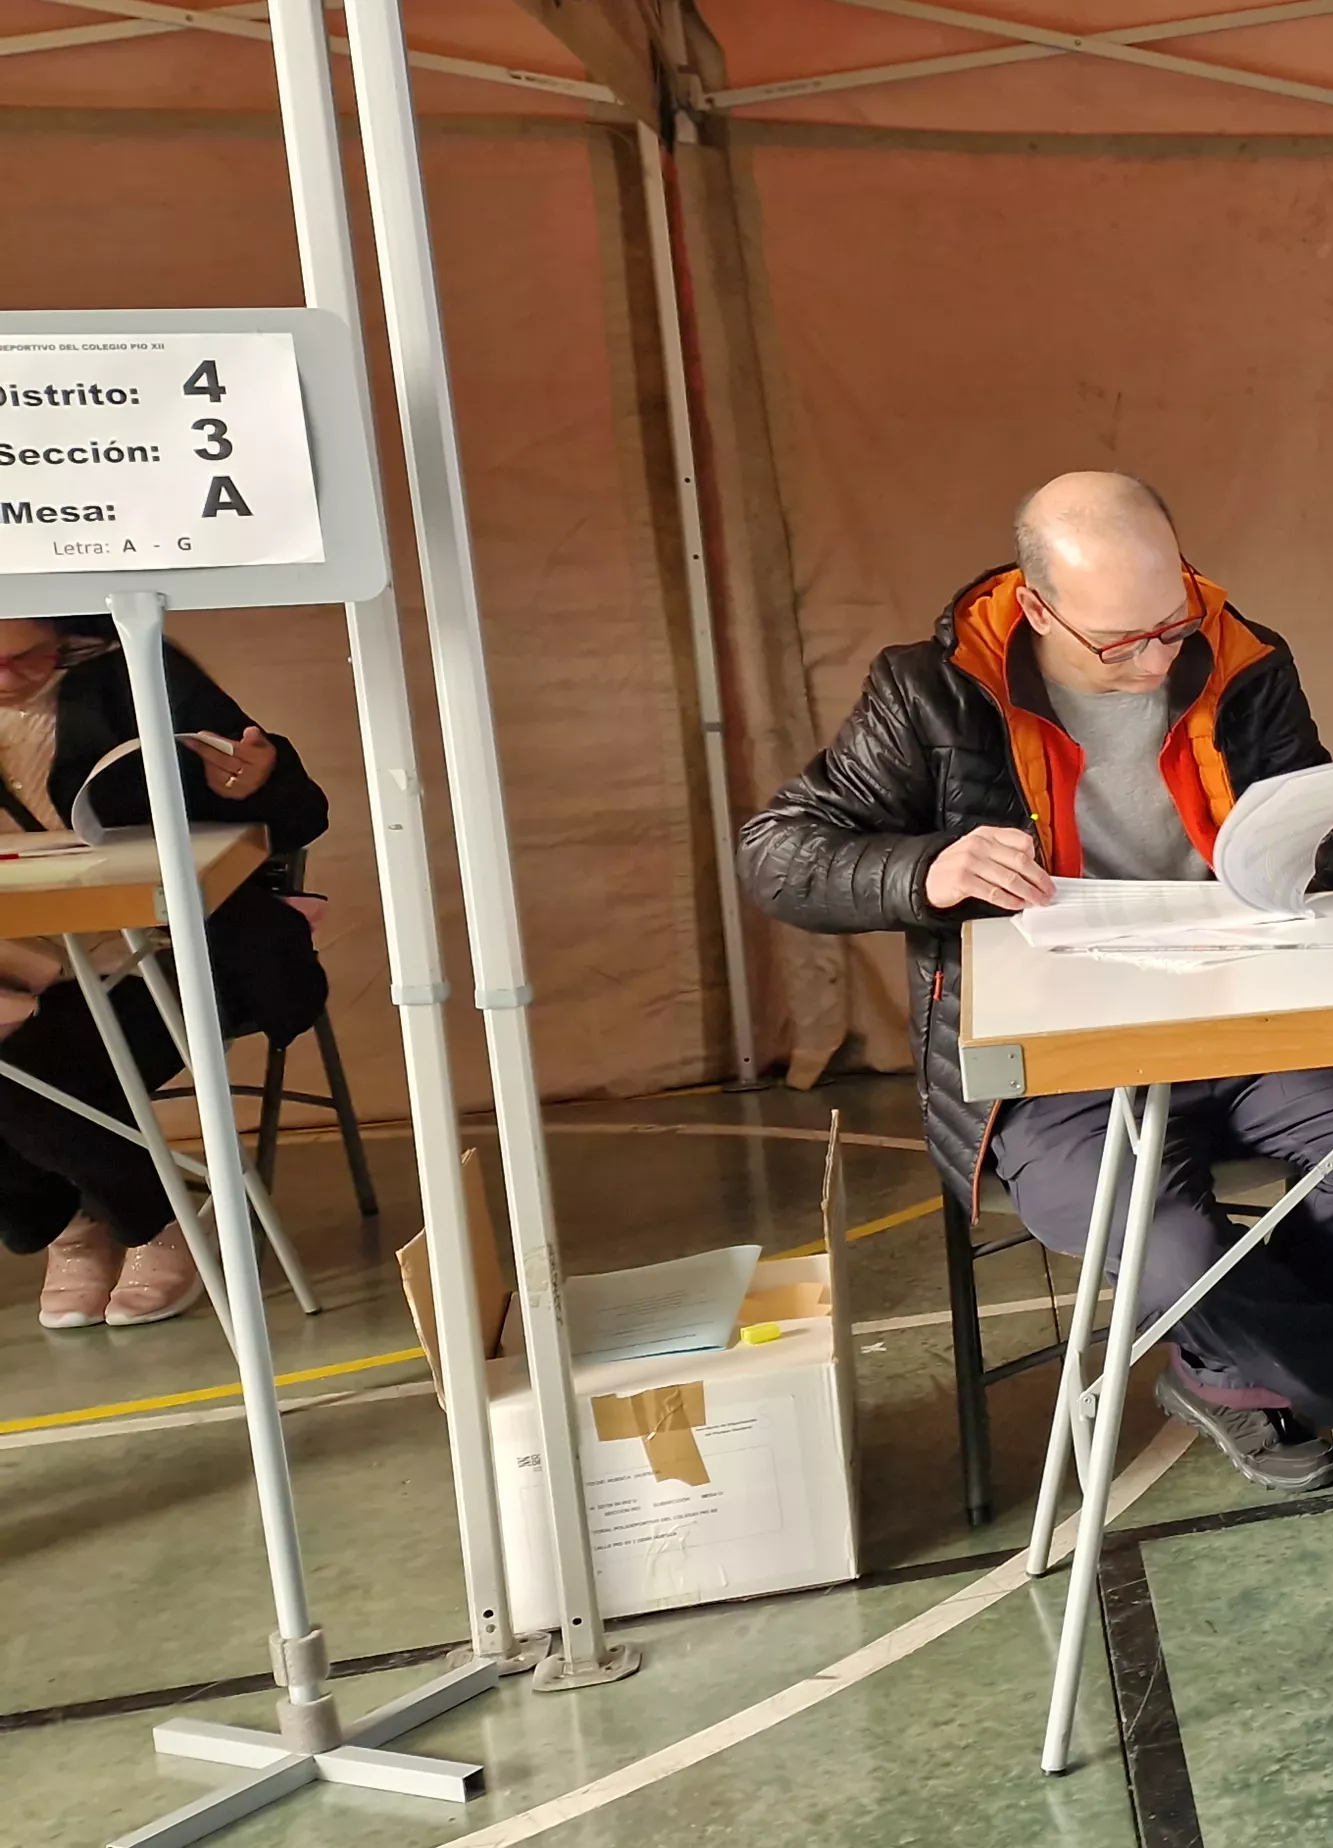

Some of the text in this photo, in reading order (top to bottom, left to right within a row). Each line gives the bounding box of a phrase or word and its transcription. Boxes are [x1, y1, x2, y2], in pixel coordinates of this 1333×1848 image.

[183, 360, 227, 403] 4
[0, 418, 234, 466] Sección: 3
[1, 476, 254, 525] Mesa: A
[53, 540, 110, 556] Letra:
[122, 538, 137, 553] A
[177, 537, 192, 551] G
